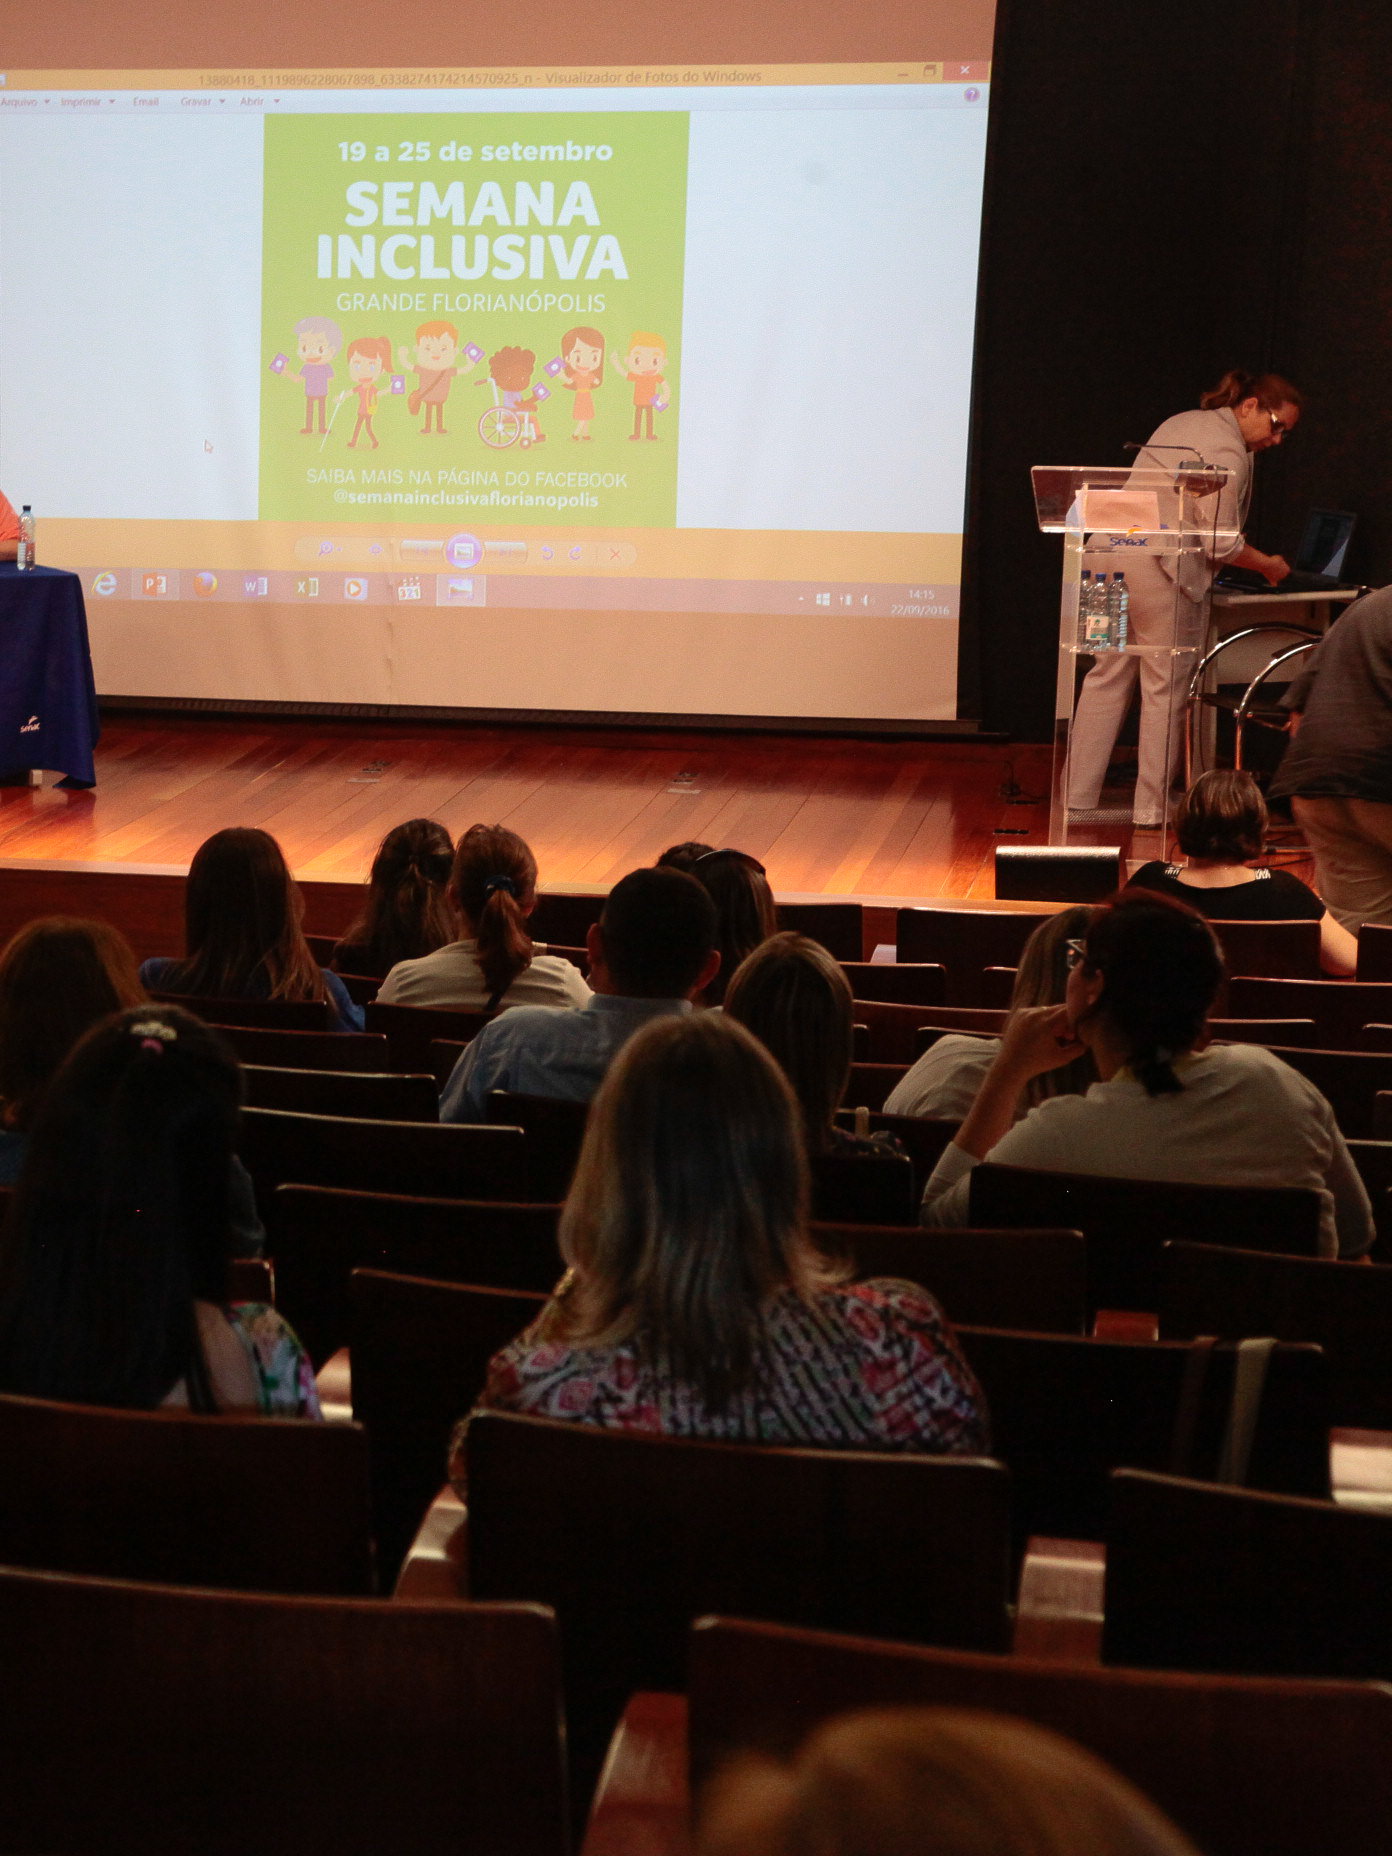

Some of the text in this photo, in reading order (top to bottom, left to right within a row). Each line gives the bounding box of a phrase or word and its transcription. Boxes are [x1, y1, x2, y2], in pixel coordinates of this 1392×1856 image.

[545, 71, 621, 85] Visualizador
[625, 70, 642, 84] de
[645, 70, 679, 84] Fotos
[682, 69, 699, 83] do
[702, 69, 762, 83] Windows
[0, 97, 38, 108] Arquivo
[61, 96, 101, 108] Imprimir
[133, 96, 159, 107] Email
[180, 96, 212, 107] Gravar
[240, 96, 264, 107] Abrir
[338, 140, 613, 162] 19 a 25 de setembro
[345, 180, 601, 227] SEMANA
[317, 234, 629, 280] INCLUSIVA
[336, 289, 606, 313] GRANDE FLORIANÓPOLIS
[307, 467, 628, 488] SAIBA MAIS NA PÁGINA DO FACEBOOK
[333, 488, 599, 511] @semanainclusivaflorianopolis
[909, 589, 935, 599] 14:15
[891, 603, 950, 616] 22/09/2016
